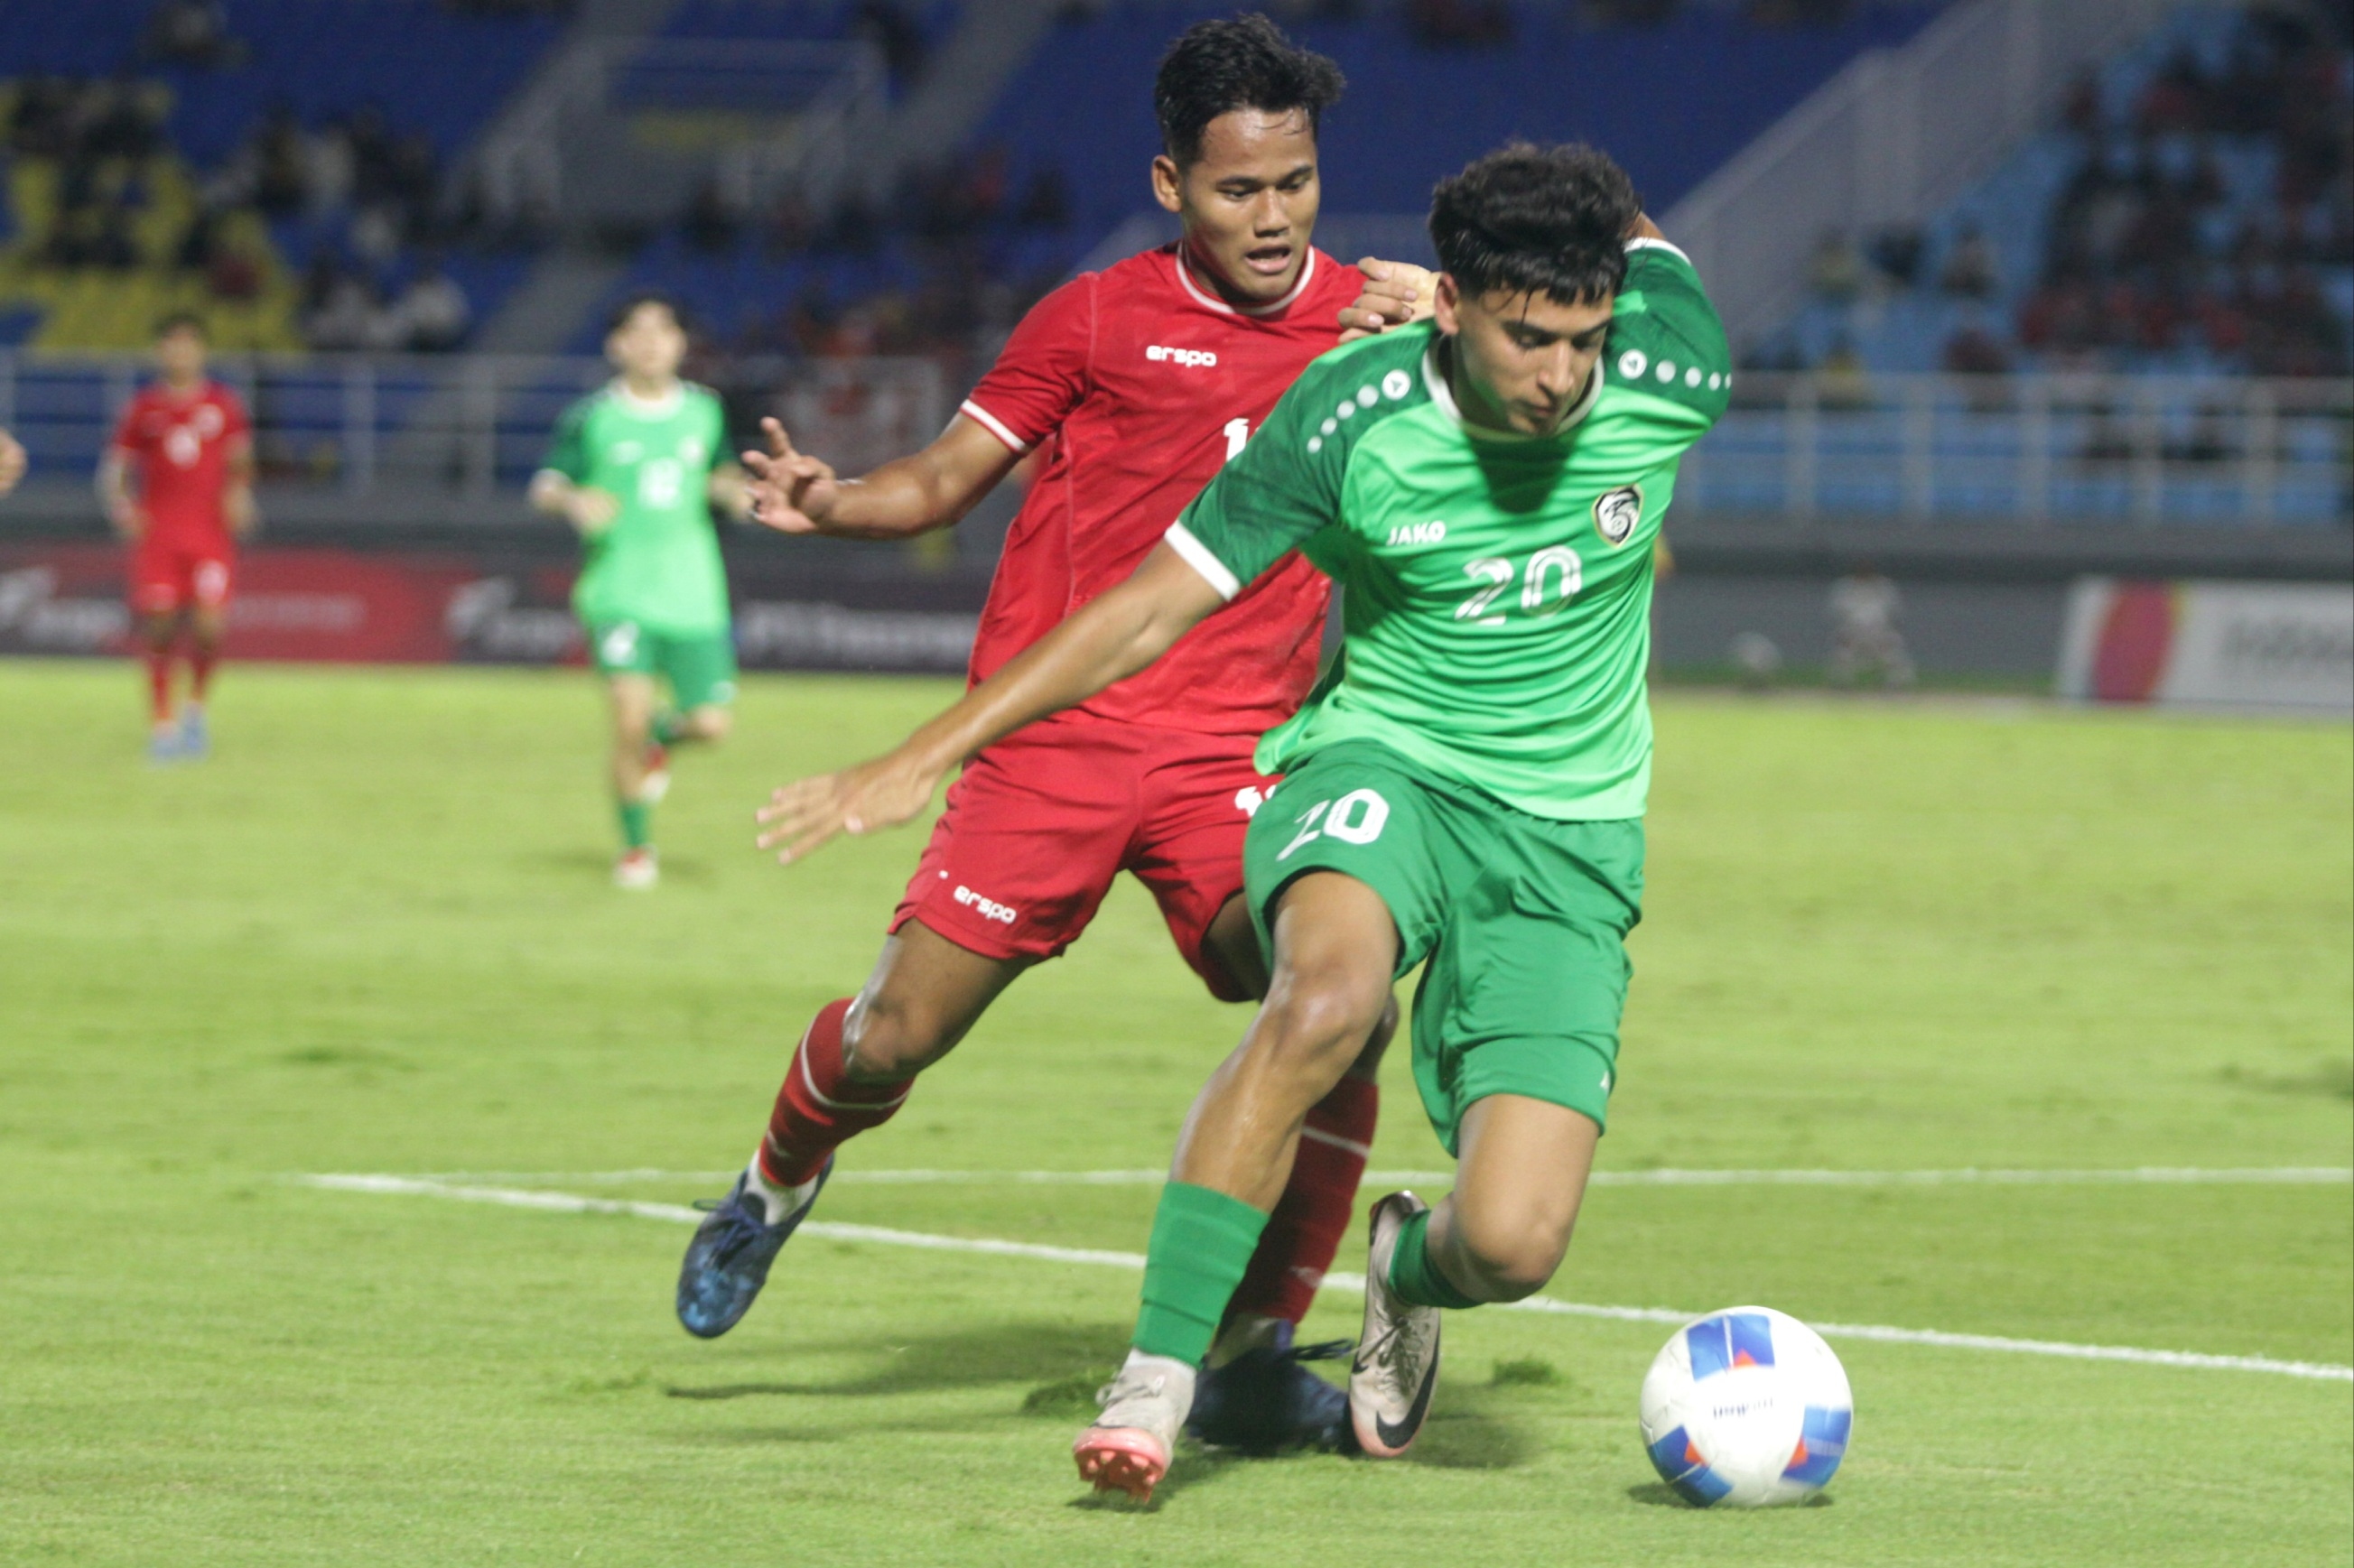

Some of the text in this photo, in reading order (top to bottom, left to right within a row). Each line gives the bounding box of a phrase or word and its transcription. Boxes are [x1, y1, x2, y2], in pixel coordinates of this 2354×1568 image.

[1145, 345, 1217, 368] erspo
[1224, 418, 1261, 462] 1
[1386, 520, 1447, 546] JAKO
[1454, 544, 1583, 626] 20
[1275, 787, 1391, 862] 20
[953, 885, 1017, 923] erspo
